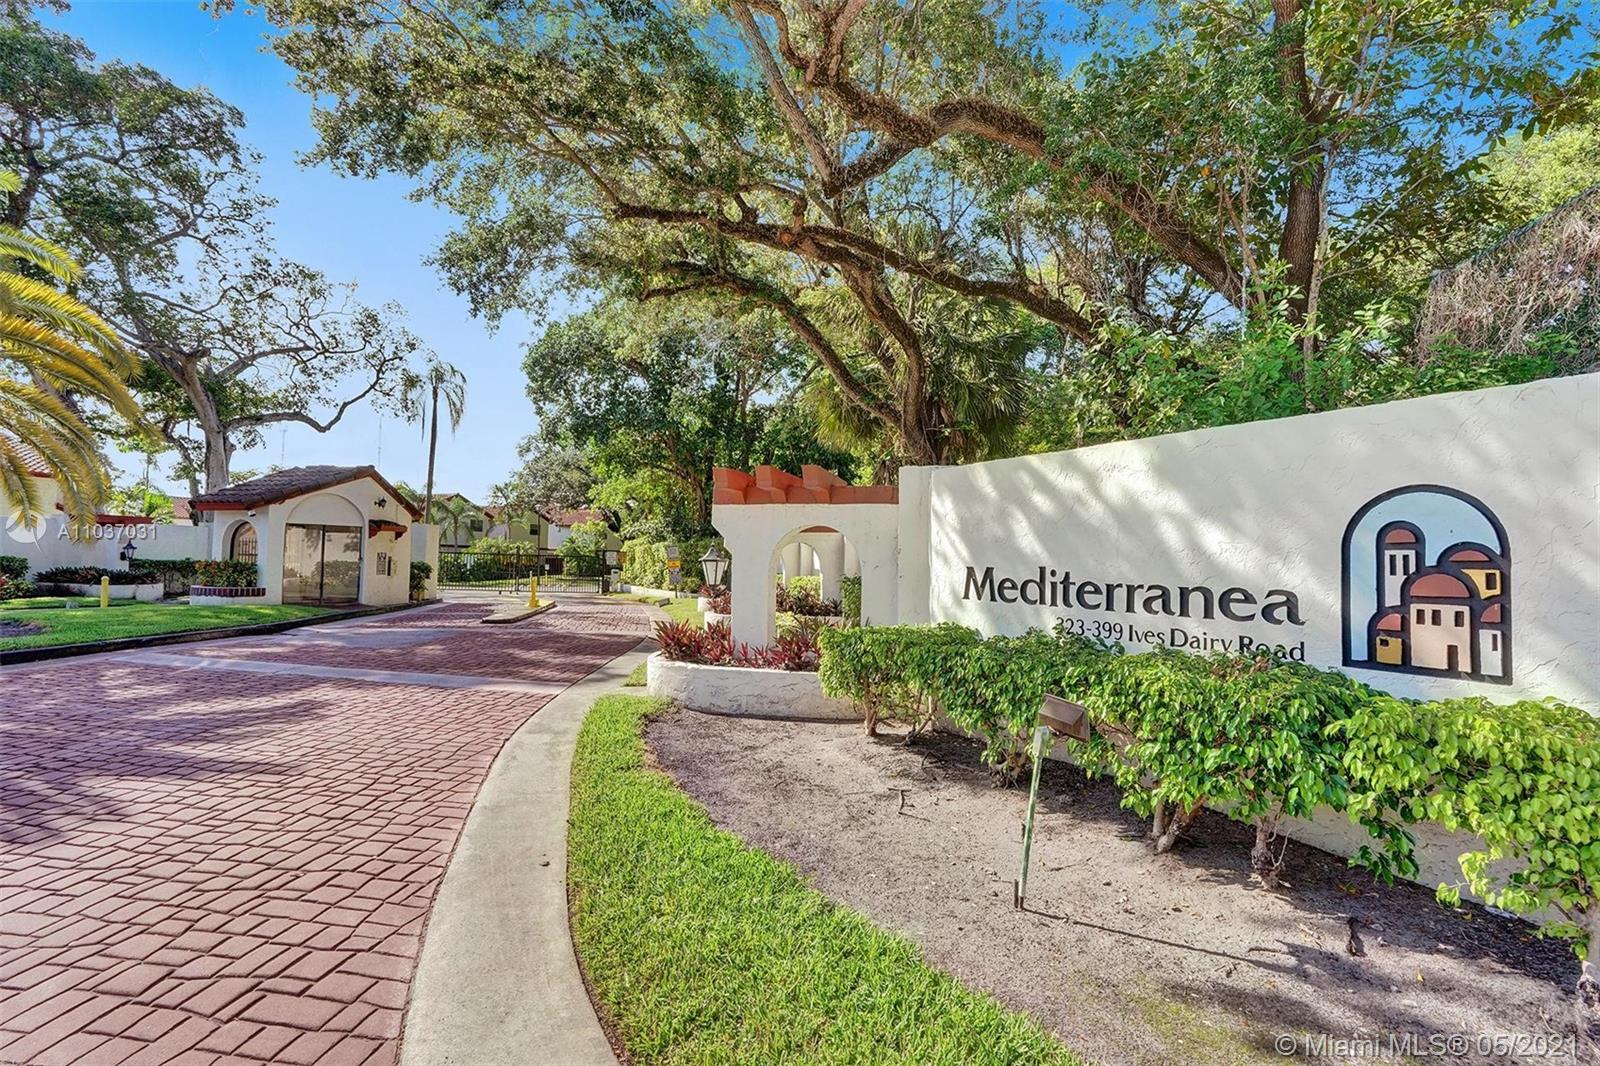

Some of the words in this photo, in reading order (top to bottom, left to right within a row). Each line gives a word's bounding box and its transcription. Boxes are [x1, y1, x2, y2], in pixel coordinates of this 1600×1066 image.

[962, 566, 1307, 626] Mediterranea
[1128, 624, 1165, 645] Ives
[1170, 628, 1233, 652] Dairy
[1238, 635, 1305, 662] Road
